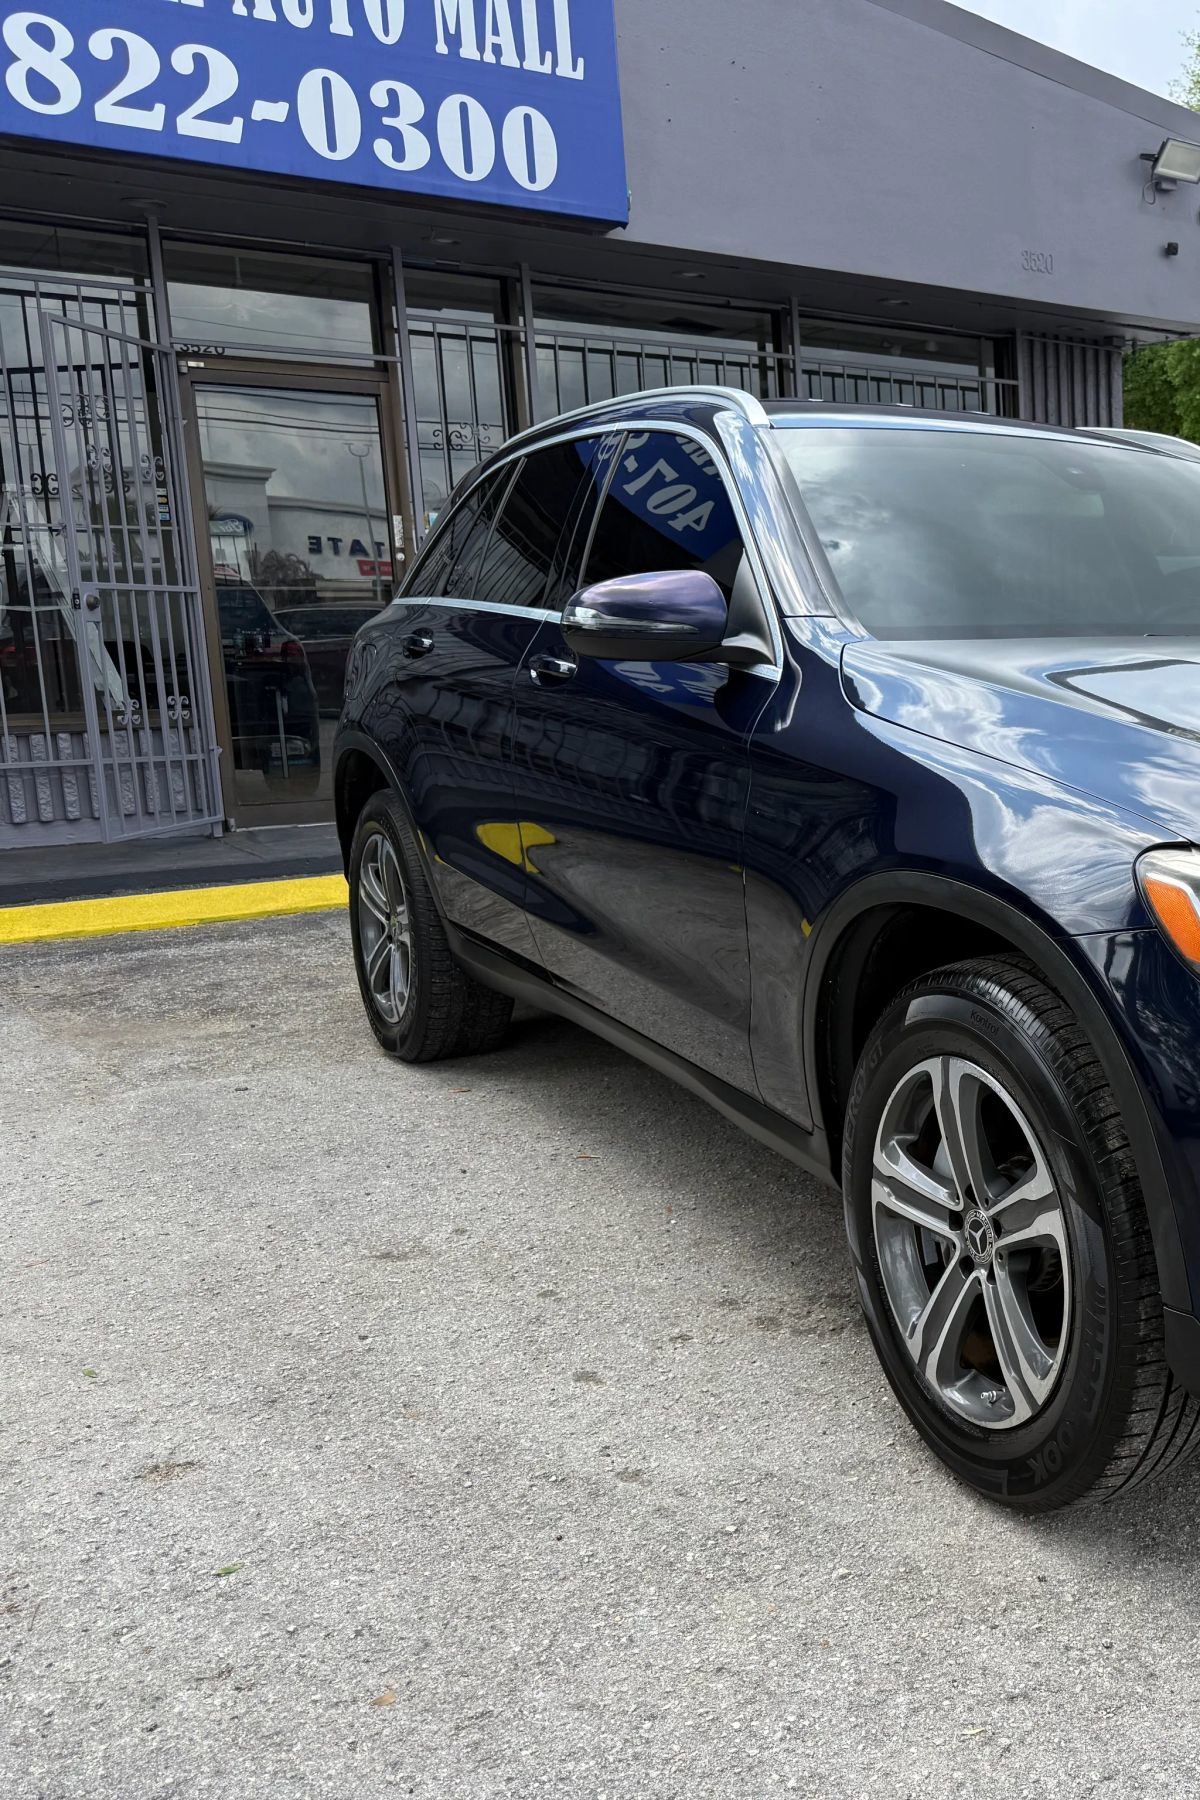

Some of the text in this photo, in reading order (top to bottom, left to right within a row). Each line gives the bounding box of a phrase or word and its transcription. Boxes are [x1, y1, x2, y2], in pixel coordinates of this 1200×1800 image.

[434, 0, 585, 80] MALL
[1, 11, 559, 192] 822-0300
[1020, 249, 1055, 275] 3520
